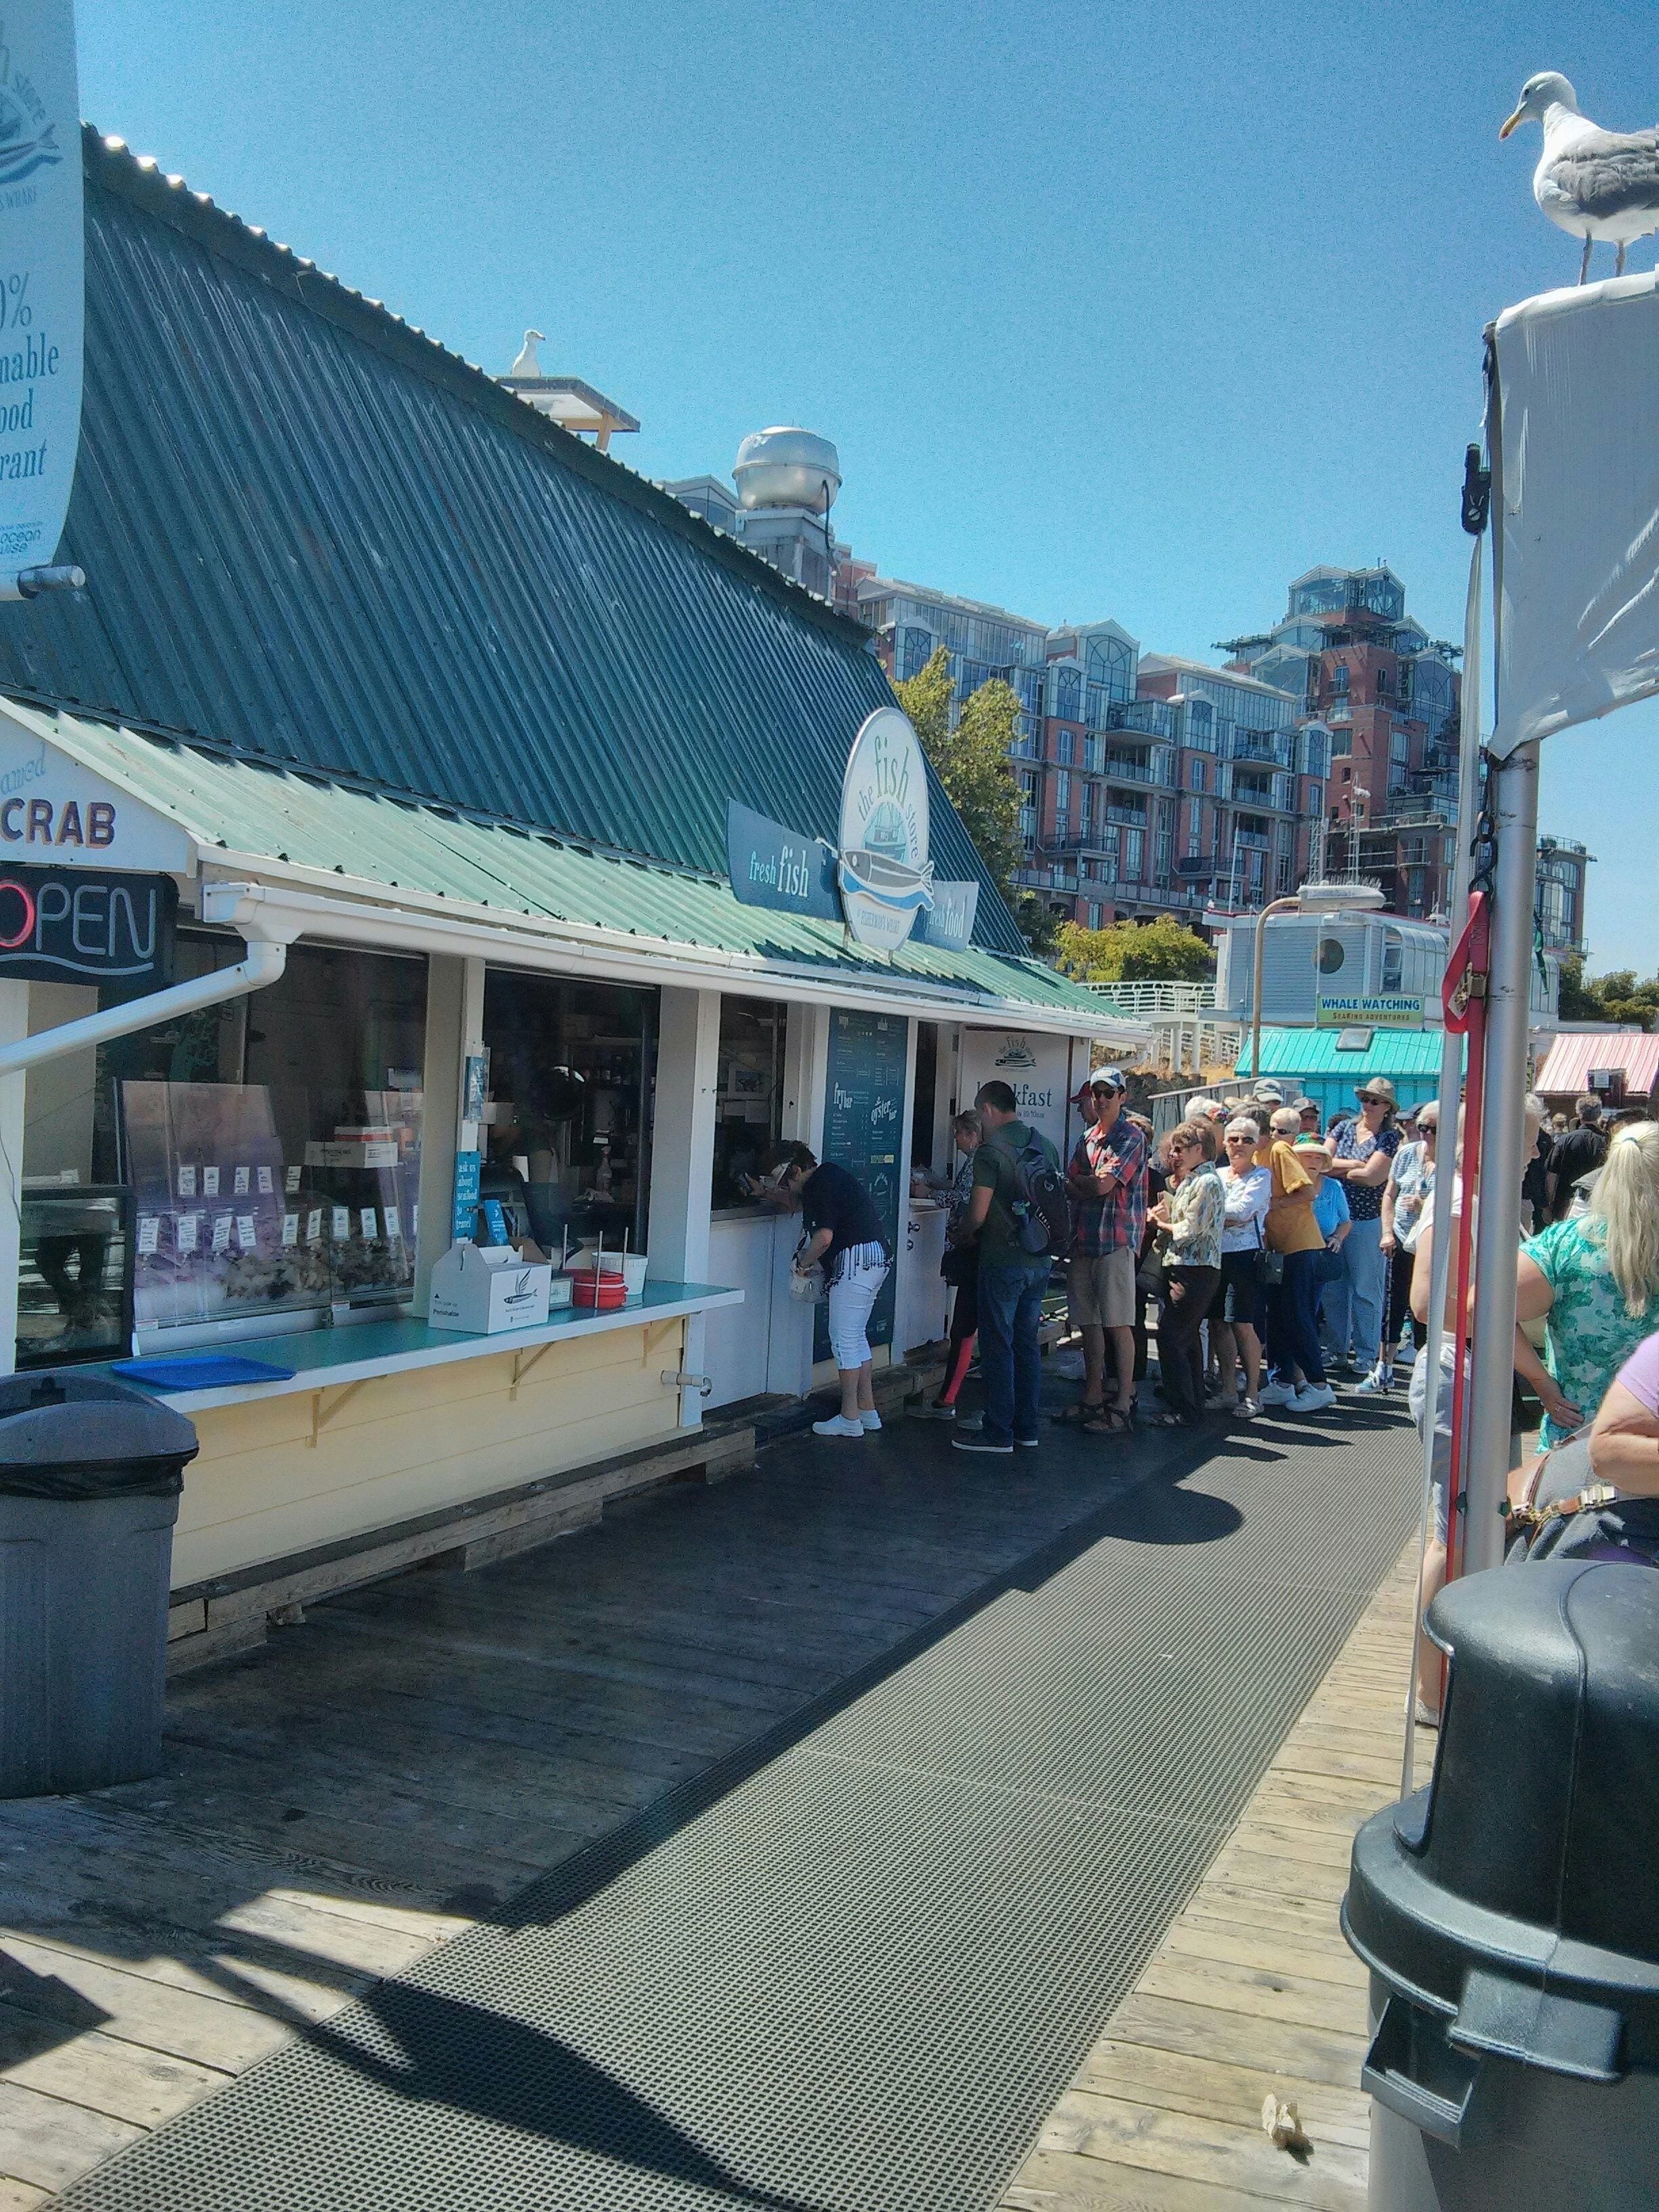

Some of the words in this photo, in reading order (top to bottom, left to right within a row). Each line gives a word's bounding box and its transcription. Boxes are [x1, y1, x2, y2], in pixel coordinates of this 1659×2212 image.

[0, 797, 117, 848] CRAB
[858, 786, 874, 822] the
[874, 735, 909, 808] fish
[905, 804, 920, 860] store
[749, 850, 776, 885] fresh
[777, 844, 808, 898] fish
[0, 878, 156, 959] OPEN
[928, 904, 945, 928] fresh
[945, 896, 965, 939] food
[1322, 999, 1358, 1010] WHALE
[1361, 999, 1420, 1010] WATCHING
[457, 1188, 478, 1201] seafood
